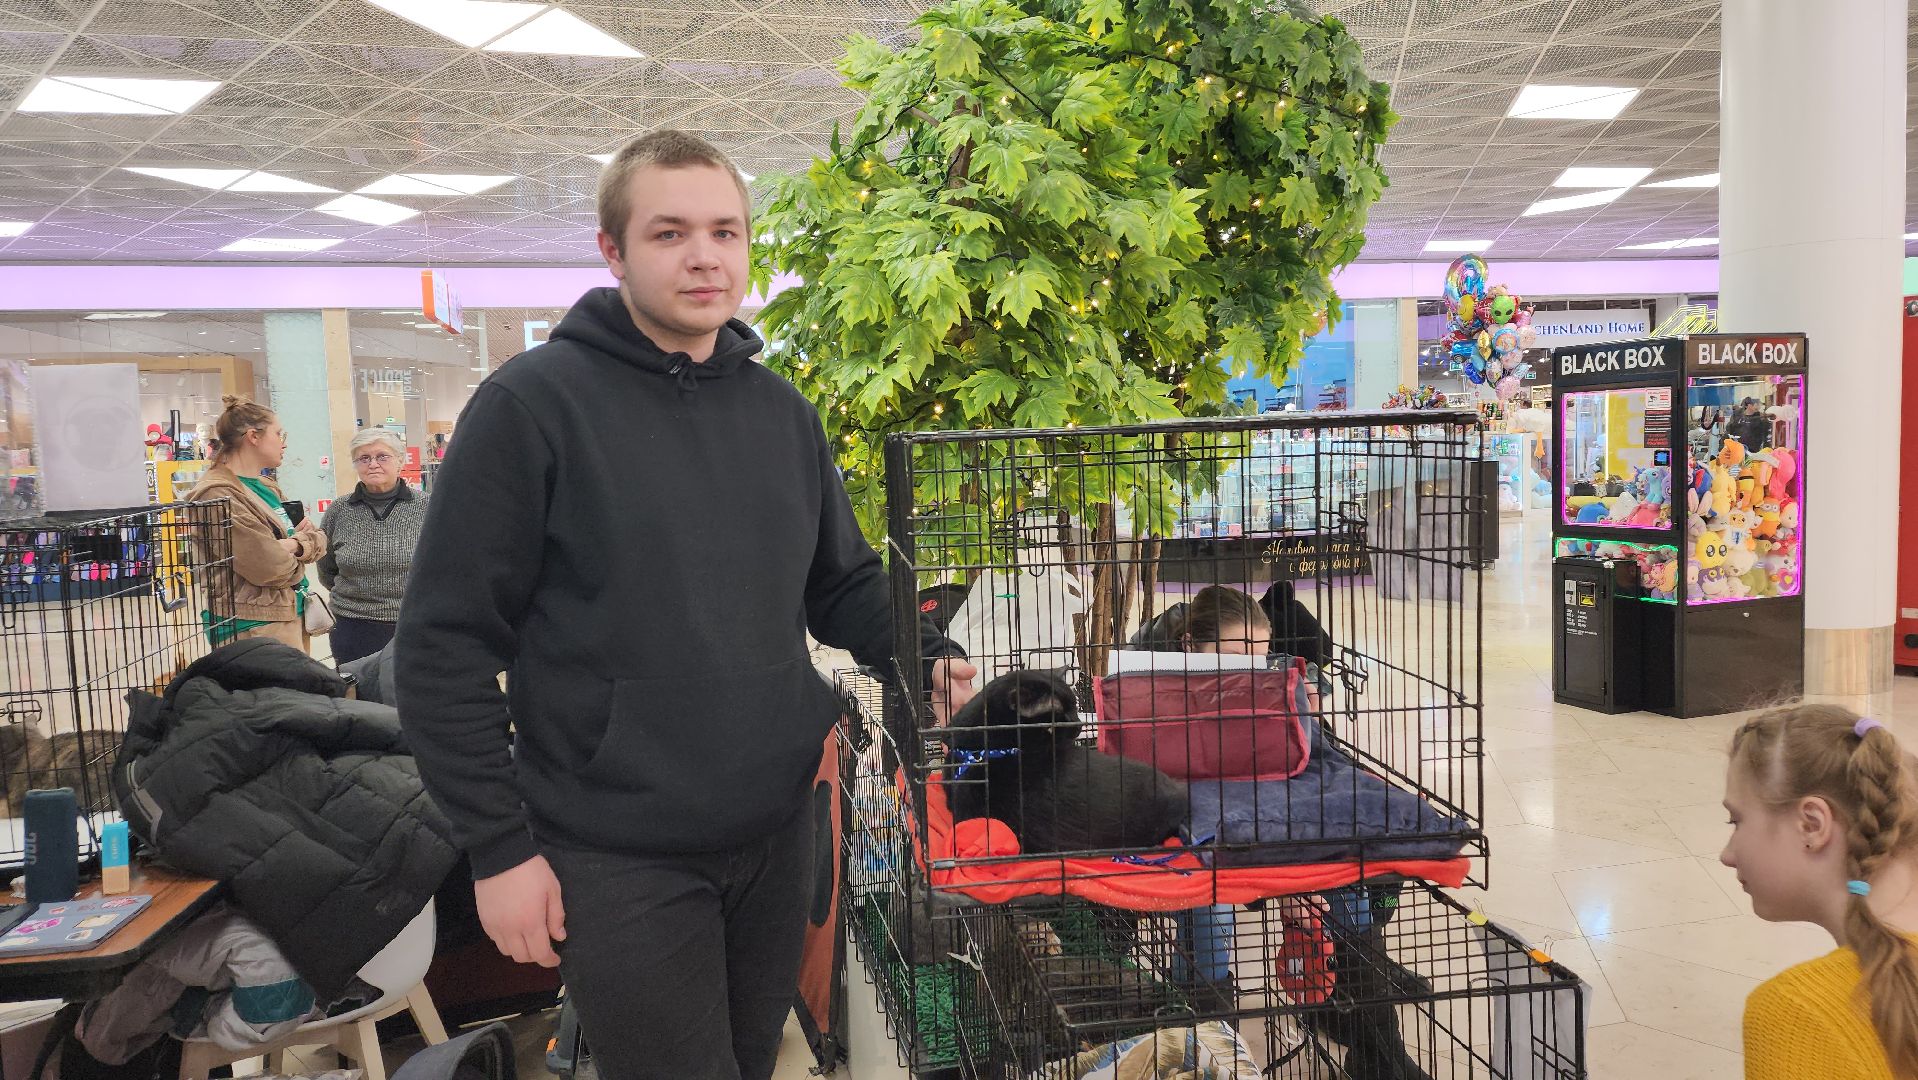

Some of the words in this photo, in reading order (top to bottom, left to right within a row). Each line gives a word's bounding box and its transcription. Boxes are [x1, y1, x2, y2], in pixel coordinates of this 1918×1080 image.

[1561, 349, 1621, 376] BLACK
[1624, 345, 1666, 369] BOX
[1698, 342, 1758, 365] BLACK
[1762, 342, 1798, 365] BOX
